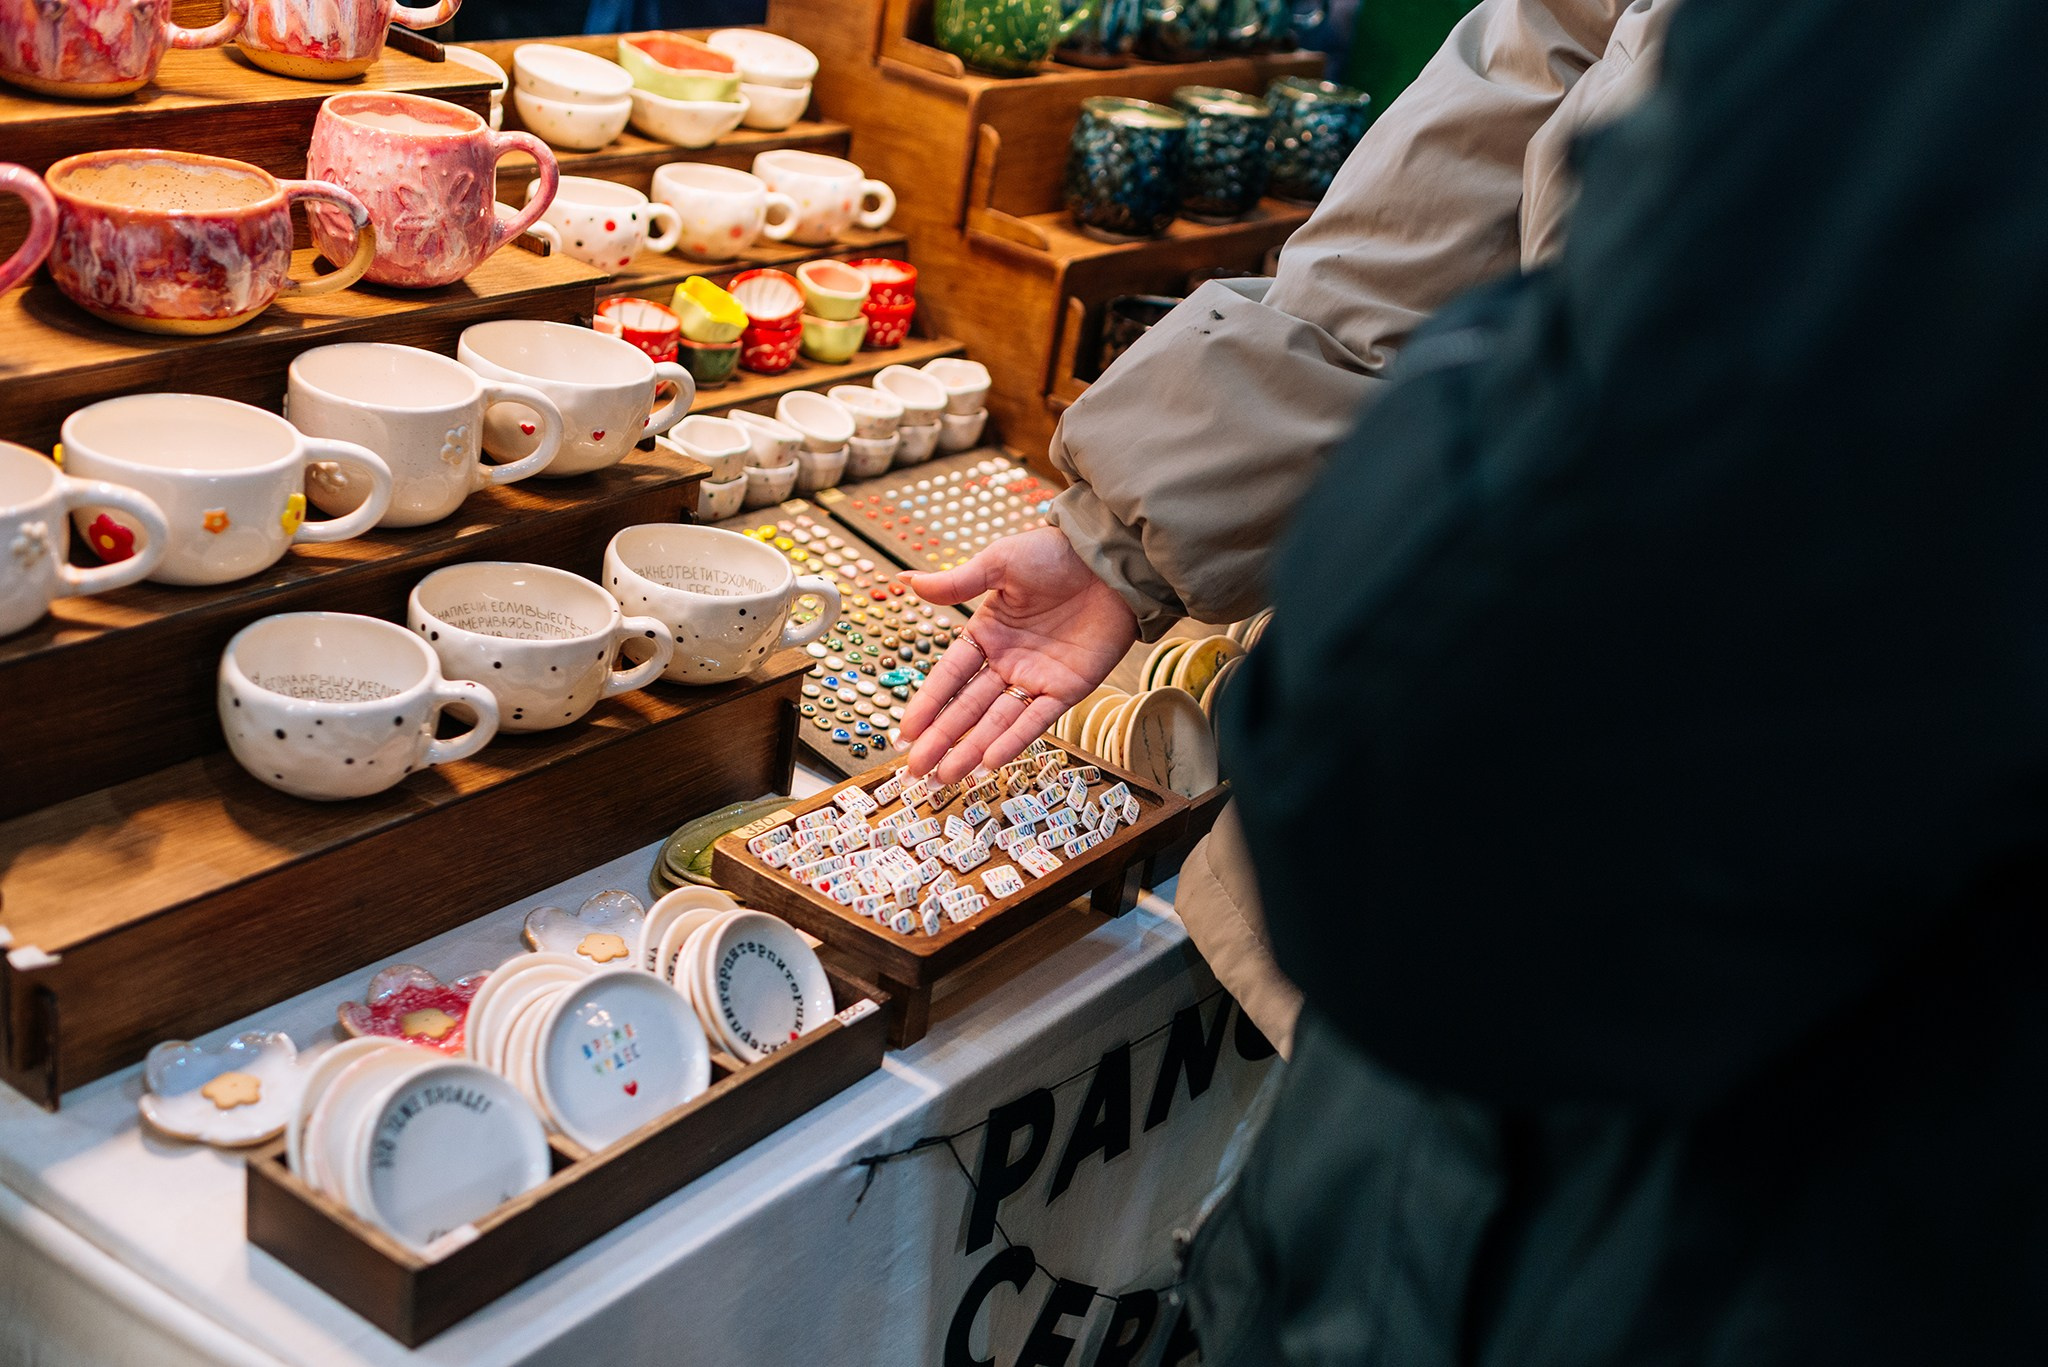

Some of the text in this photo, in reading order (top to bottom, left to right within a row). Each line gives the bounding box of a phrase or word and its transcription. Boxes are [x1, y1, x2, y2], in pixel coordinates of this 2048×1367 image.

[743, 817, 776, 836] 350
[1000, 821, 1035, 848] ДУРАЧОК
[875, 829, 897, 849] ДЕД
[921, 860, 940, 881] ДНО
